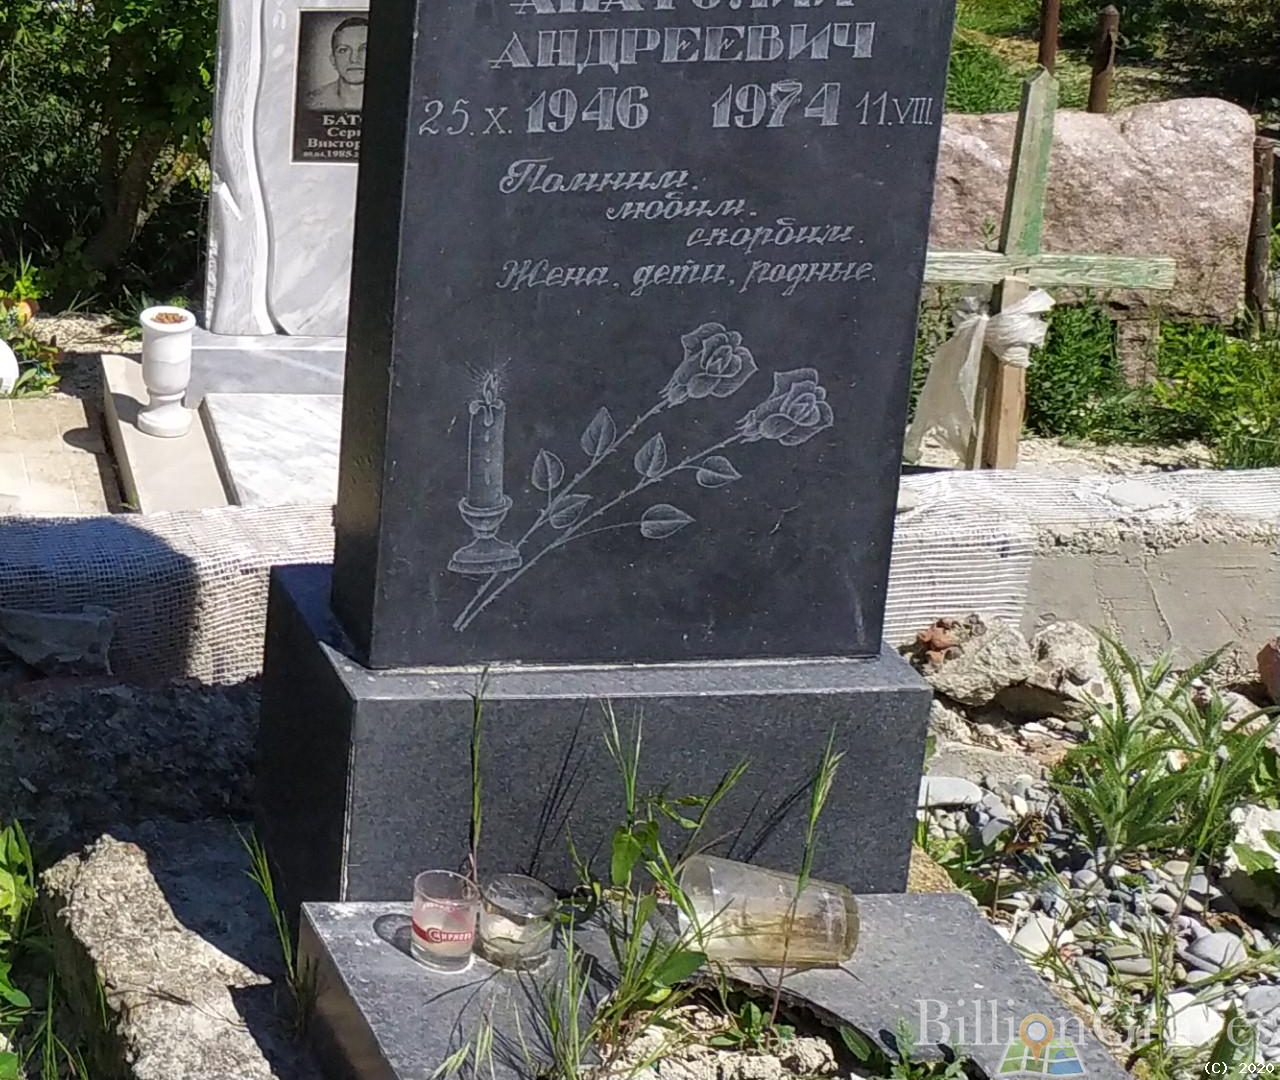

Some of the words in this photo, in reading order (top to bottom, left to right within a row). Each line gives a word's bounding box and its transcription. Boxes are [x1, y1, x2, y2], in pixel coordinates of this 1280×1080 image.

[488, 22, 875, 74] АНДРЕЕВИЧ
[322, 114, 362, 125] БАТ
[525, 86, 649, 133] 1946
[712, 79, 840, 128] 1974
